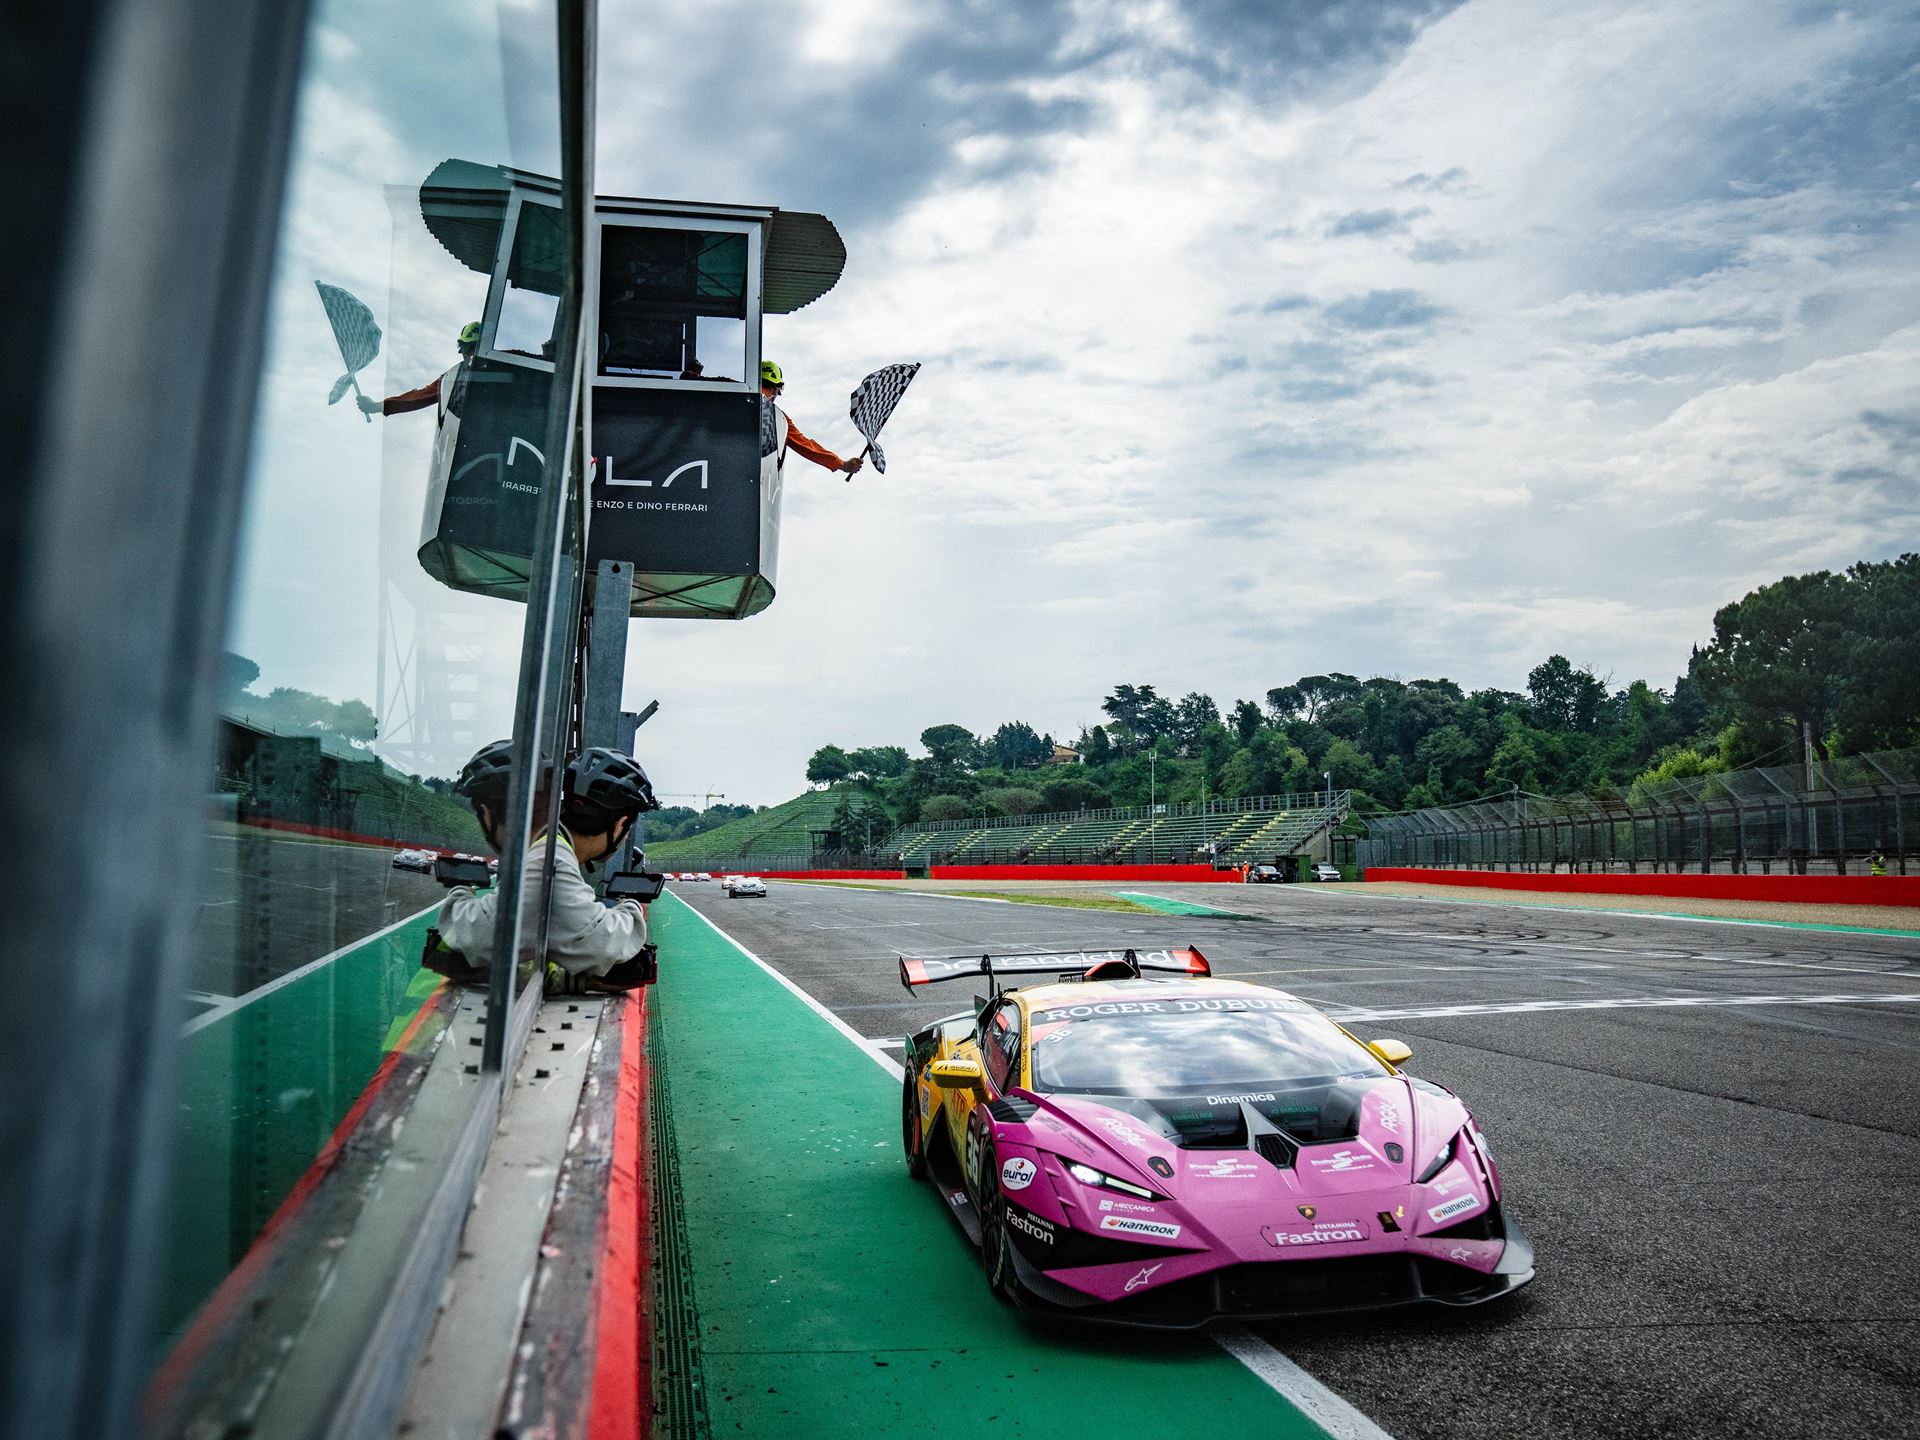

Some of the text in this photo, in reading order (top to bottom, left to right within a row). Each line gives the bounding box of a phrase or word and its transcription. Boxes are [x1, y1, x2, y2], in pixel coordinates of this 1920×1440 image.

[597, 500, 625, 509] ENZO
[627, 501, 633, 509] E
[637, 502, 663, 510] DINO
[666, 503, 708, 512] FERRARI
[1000, 950, 1173, 967] randstd
[1046, 999, 1300, 1021] ROGER DUBUIS
[1043, 1028, 1073, 1044] 36
[1206, 1093, 1276, 1106] Dinamica
[1003, 1169, 1033, 1182] eurol
[1113, 1202, 1155, 1213] MECCANICA
[1006, 1206, 1054, 1245] Fastron
[1027, 1212, 1055, 1231] PERTAMINA
[1314, 1222, 1357, 1230] PERTAMINA
[1275, 1229, 1363, 1245] Fastron
